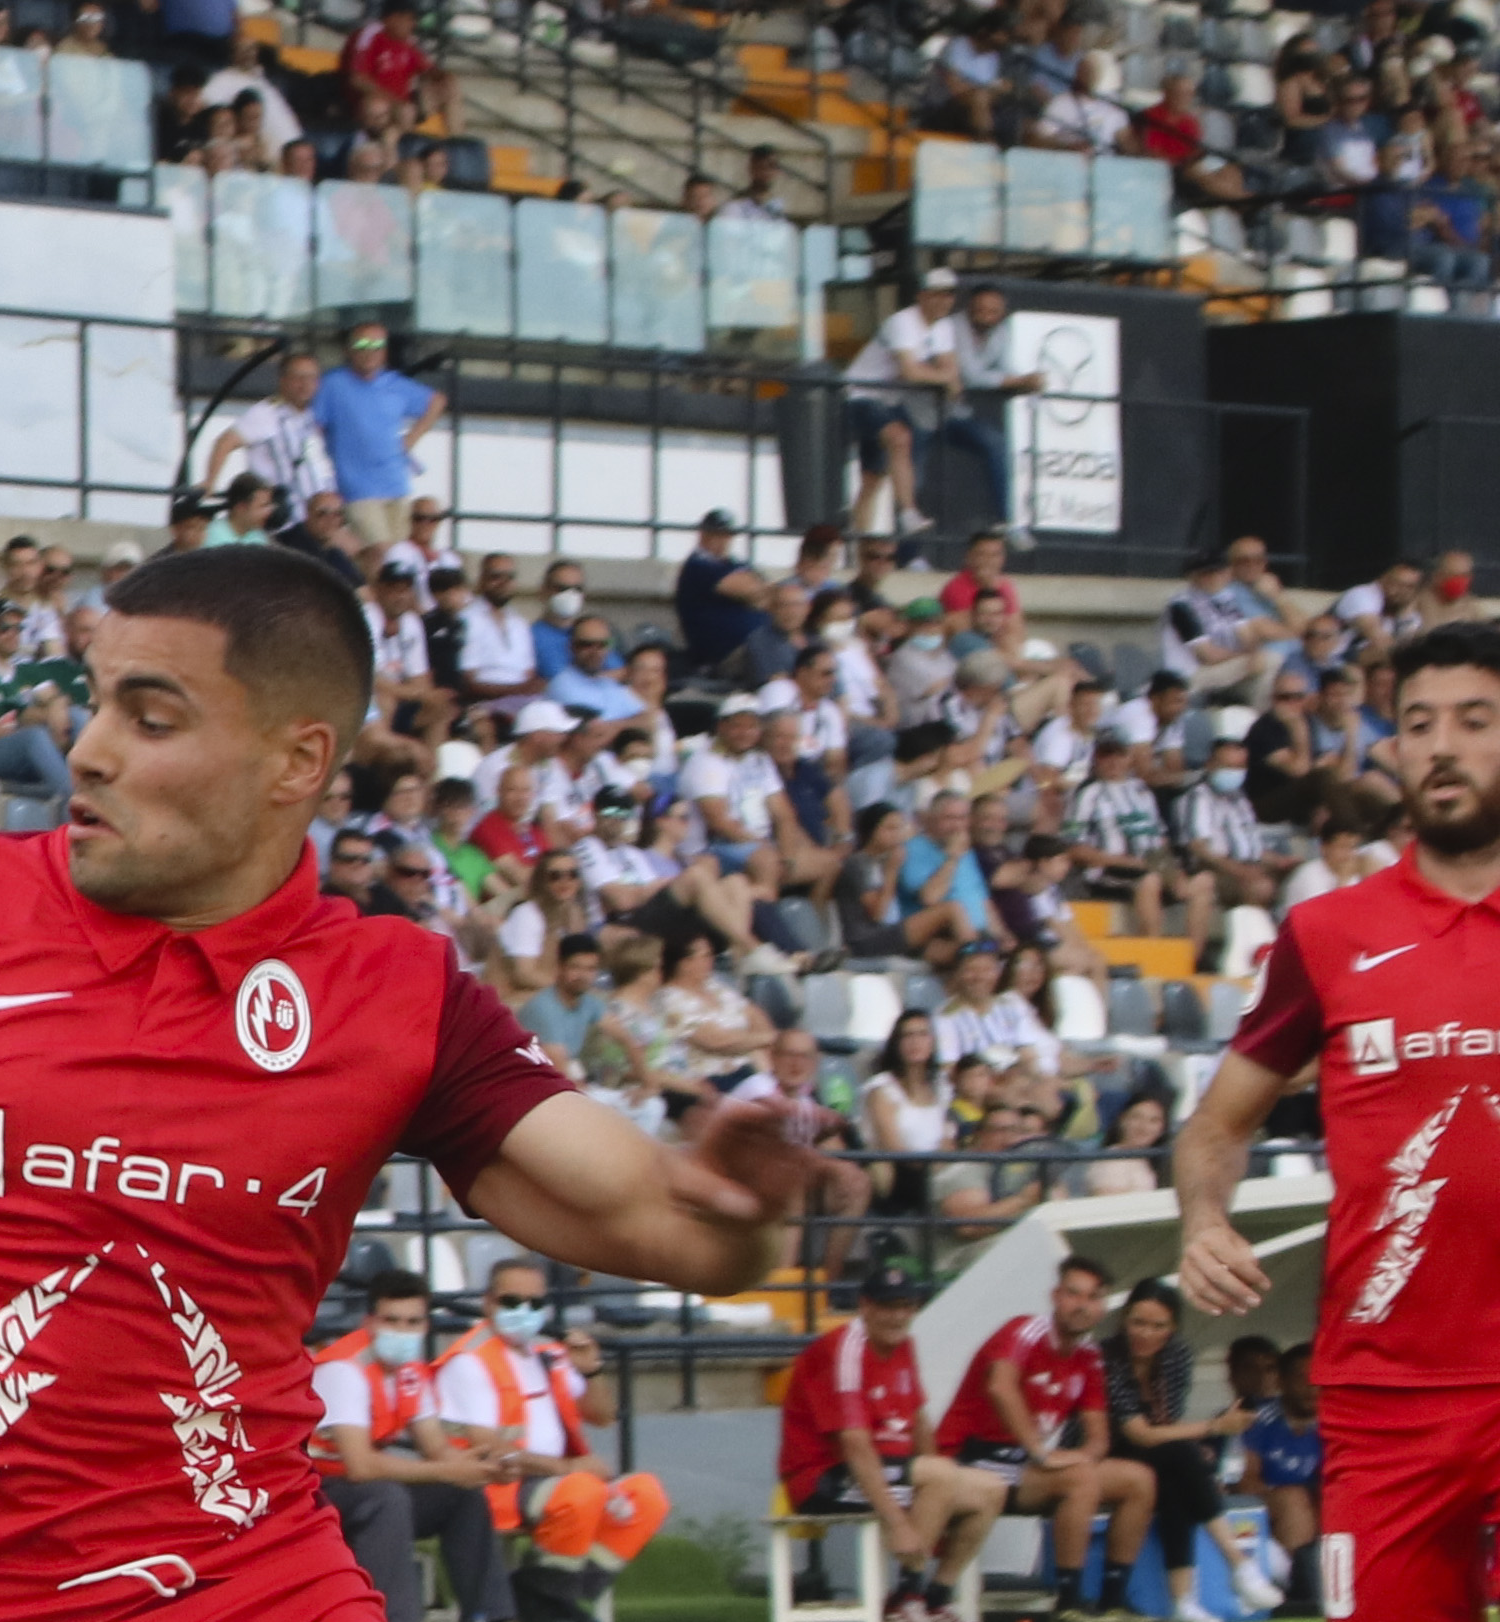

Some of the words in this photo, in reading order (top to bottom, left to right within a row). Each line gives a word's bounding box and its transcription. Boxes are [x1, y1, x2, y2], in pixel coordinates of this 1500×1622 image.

[1403, 1020, 1500, 1061] afa
[22, 1135, 225, 1205] afar
[277, 1166, 328, 1218] 4
